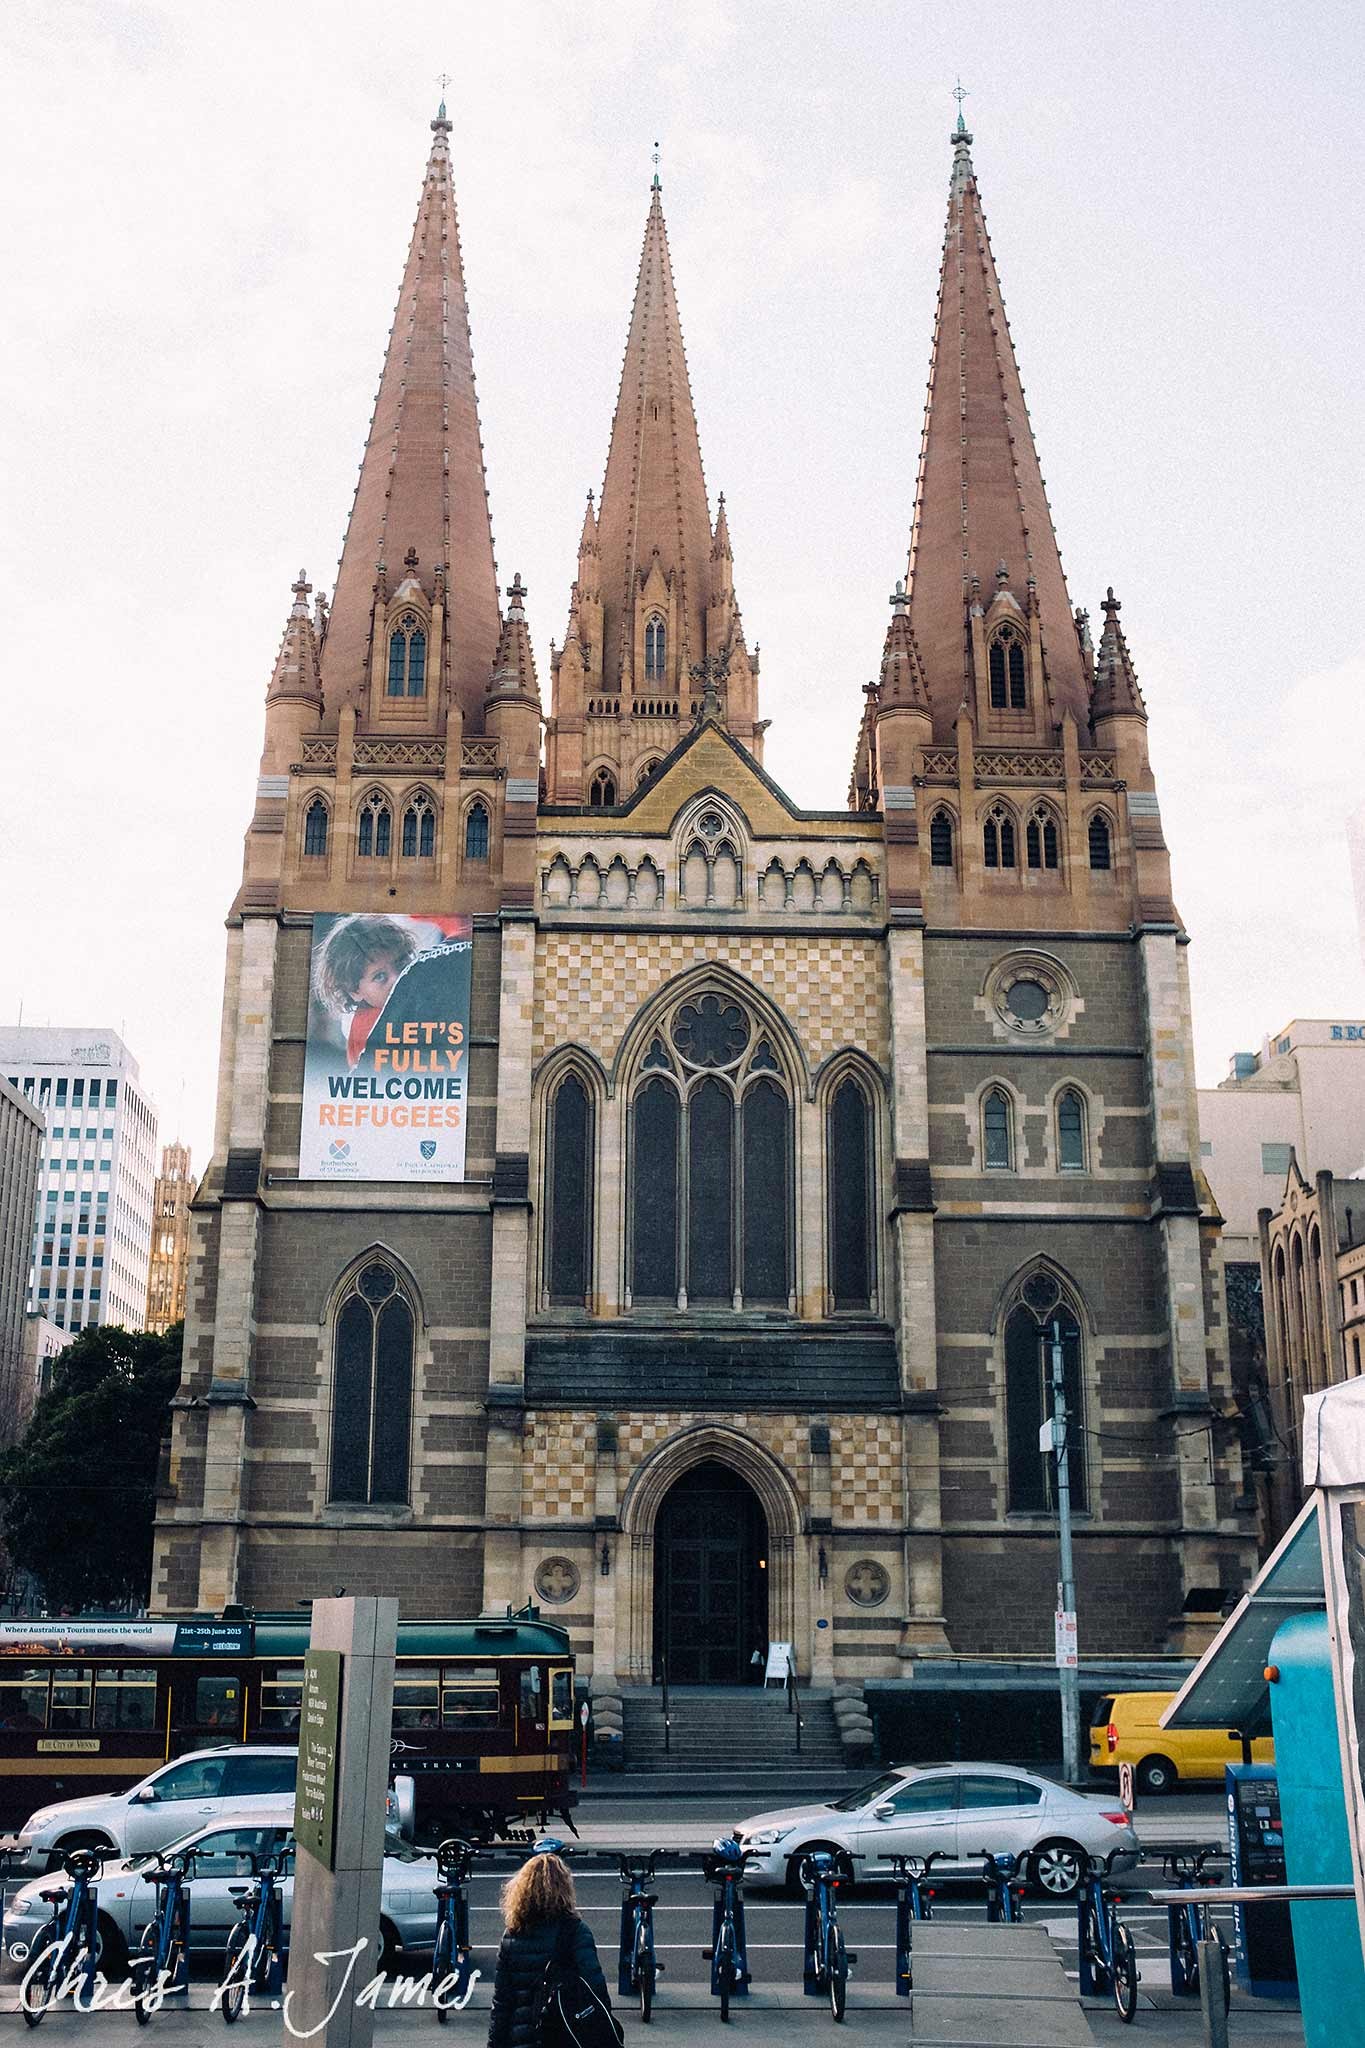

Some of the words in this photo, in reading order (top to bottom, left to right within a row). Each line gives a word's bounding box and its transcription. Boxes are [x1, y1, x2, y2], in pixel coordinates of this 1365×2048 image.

[385, 1021, 464, 1045] LET'S
[374, 1049, 464, 1073] FULLY
[328, 1076, 462, 1100] WELCOME
[319, 1103, 461, 1128] REFUGEES
[4, 1626, 28, 1634] Where
[28, 1626, 66, 1634] Australian
[66, 1626, 96, 1634] Tourism
[120, 1626, 132, 1634] the
[132, 1626, 153, 1634] world
[211, 1628, 226, 1636] June
